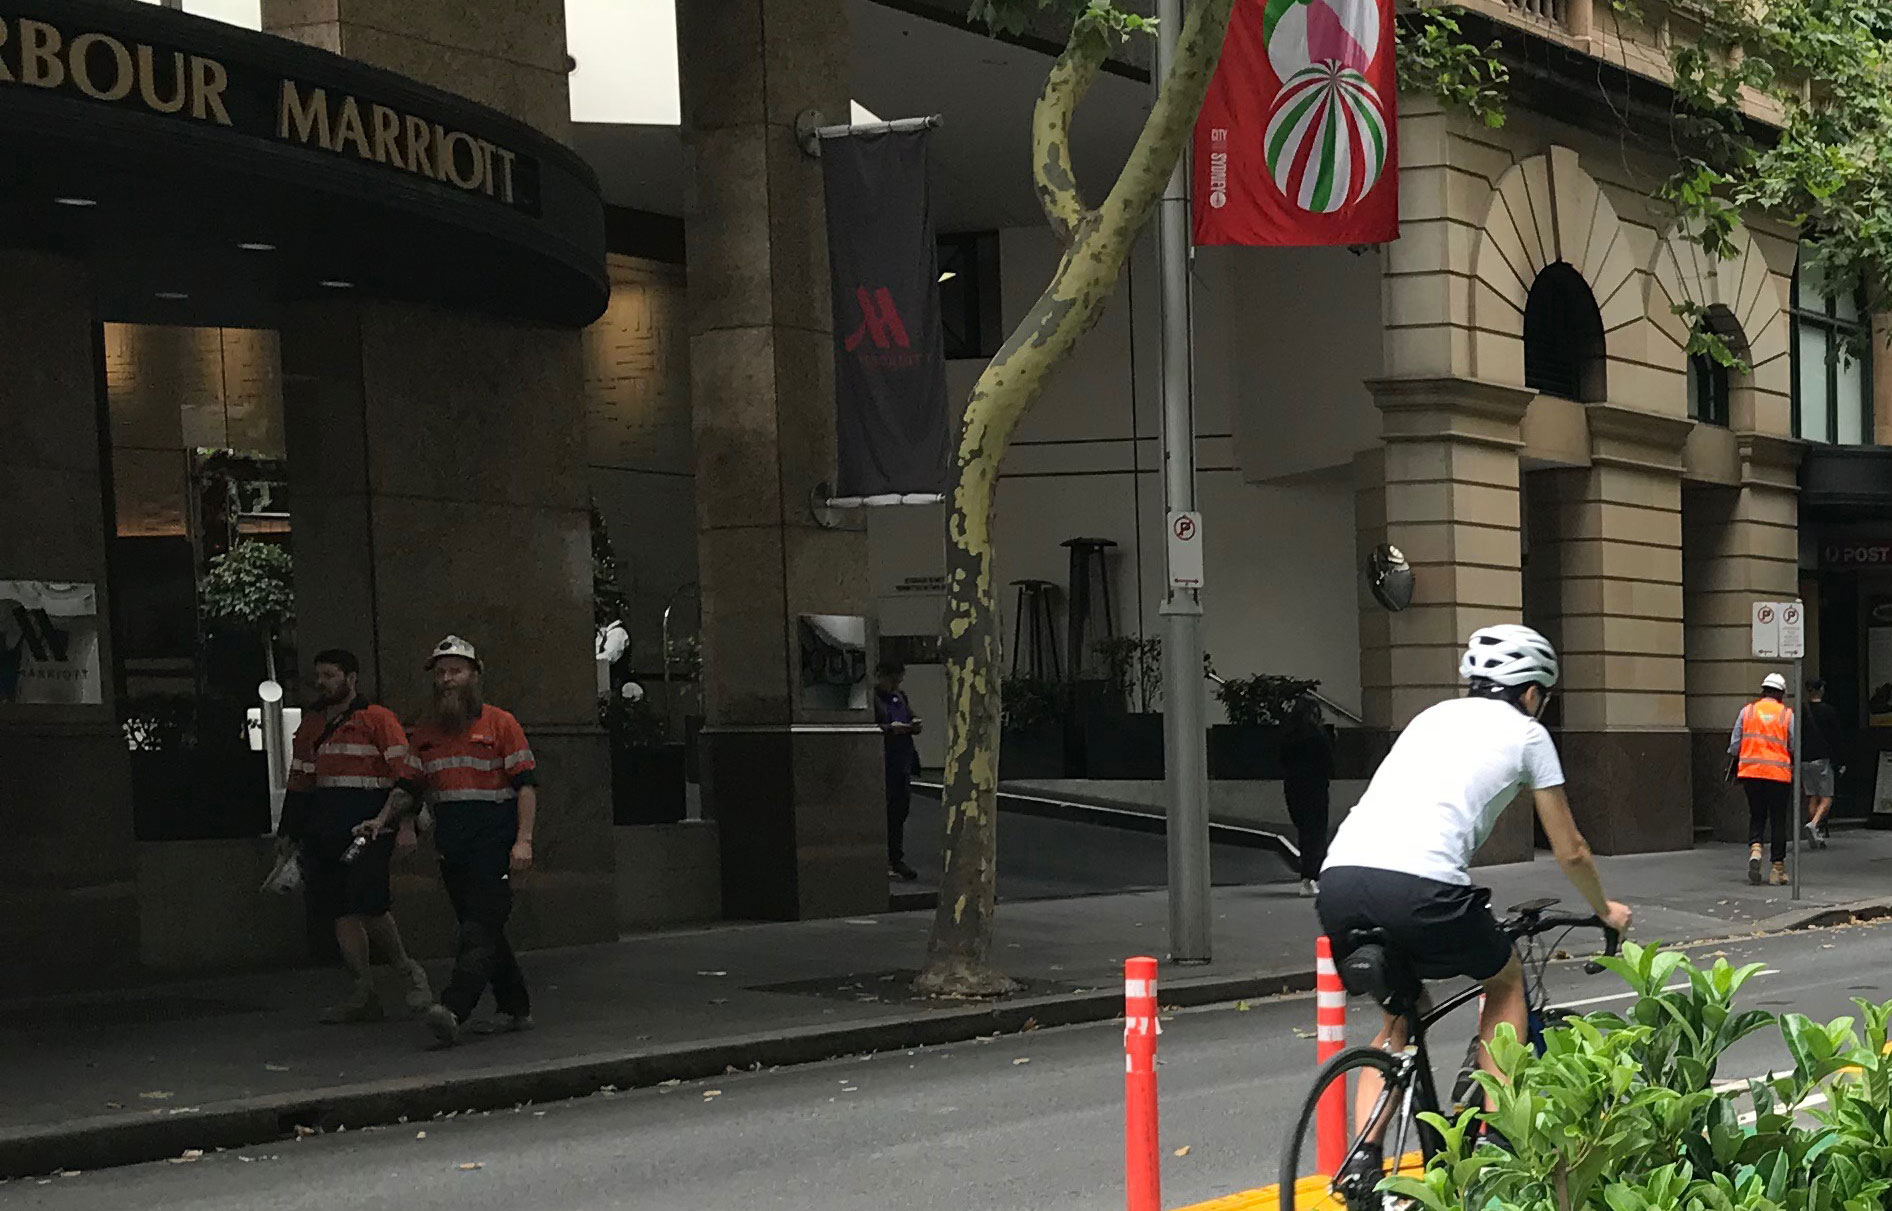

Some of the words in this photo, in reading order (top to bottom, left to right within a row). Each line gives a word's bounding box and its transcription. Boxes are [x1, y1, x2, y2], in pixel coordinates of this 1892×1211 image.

[278, 79, 515, 203] MARRIOTT
[1210, 152, 1227, 193] SYDNEY
[1844, 547, 1890, 562] POST
